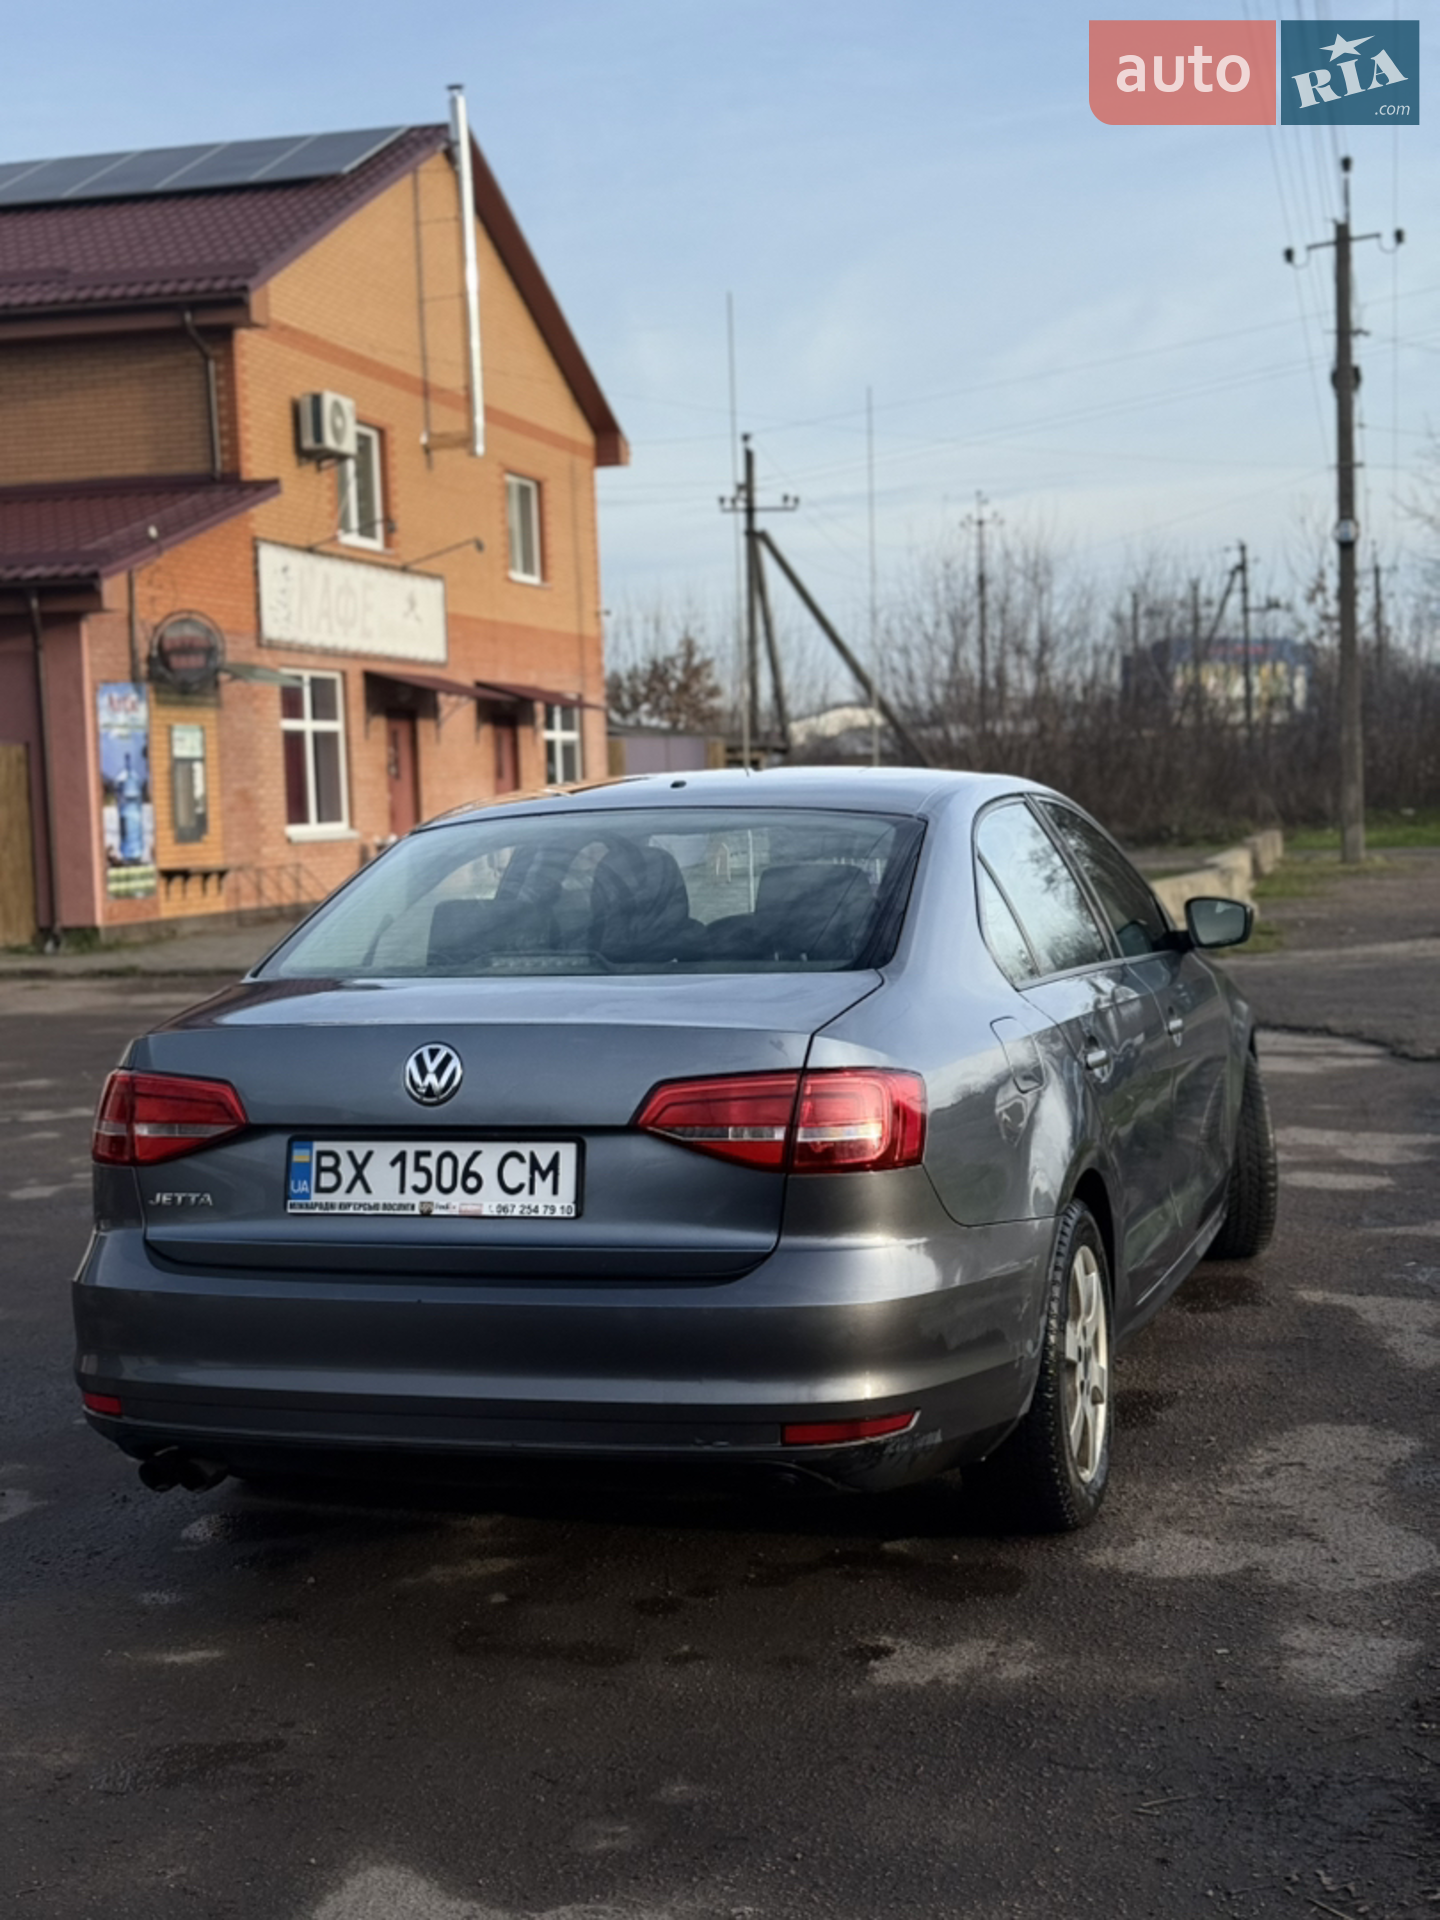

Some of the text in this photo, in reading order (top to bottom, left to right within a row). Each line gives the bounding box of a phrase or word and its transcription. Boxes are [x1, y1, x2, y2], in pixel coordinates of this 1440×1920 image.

[313, 1150, 561, 1197] BX 1506 CM
[290, 1179, 310, 1194] UA
[149, 1192, 213, 1206] JETTA
[495, 1203, 516, 1214] 067
[519, 1204, 539, 1214] 254
[543, 1204, 556, 1215] 79
[560, 1204, 574, 1215] 10
